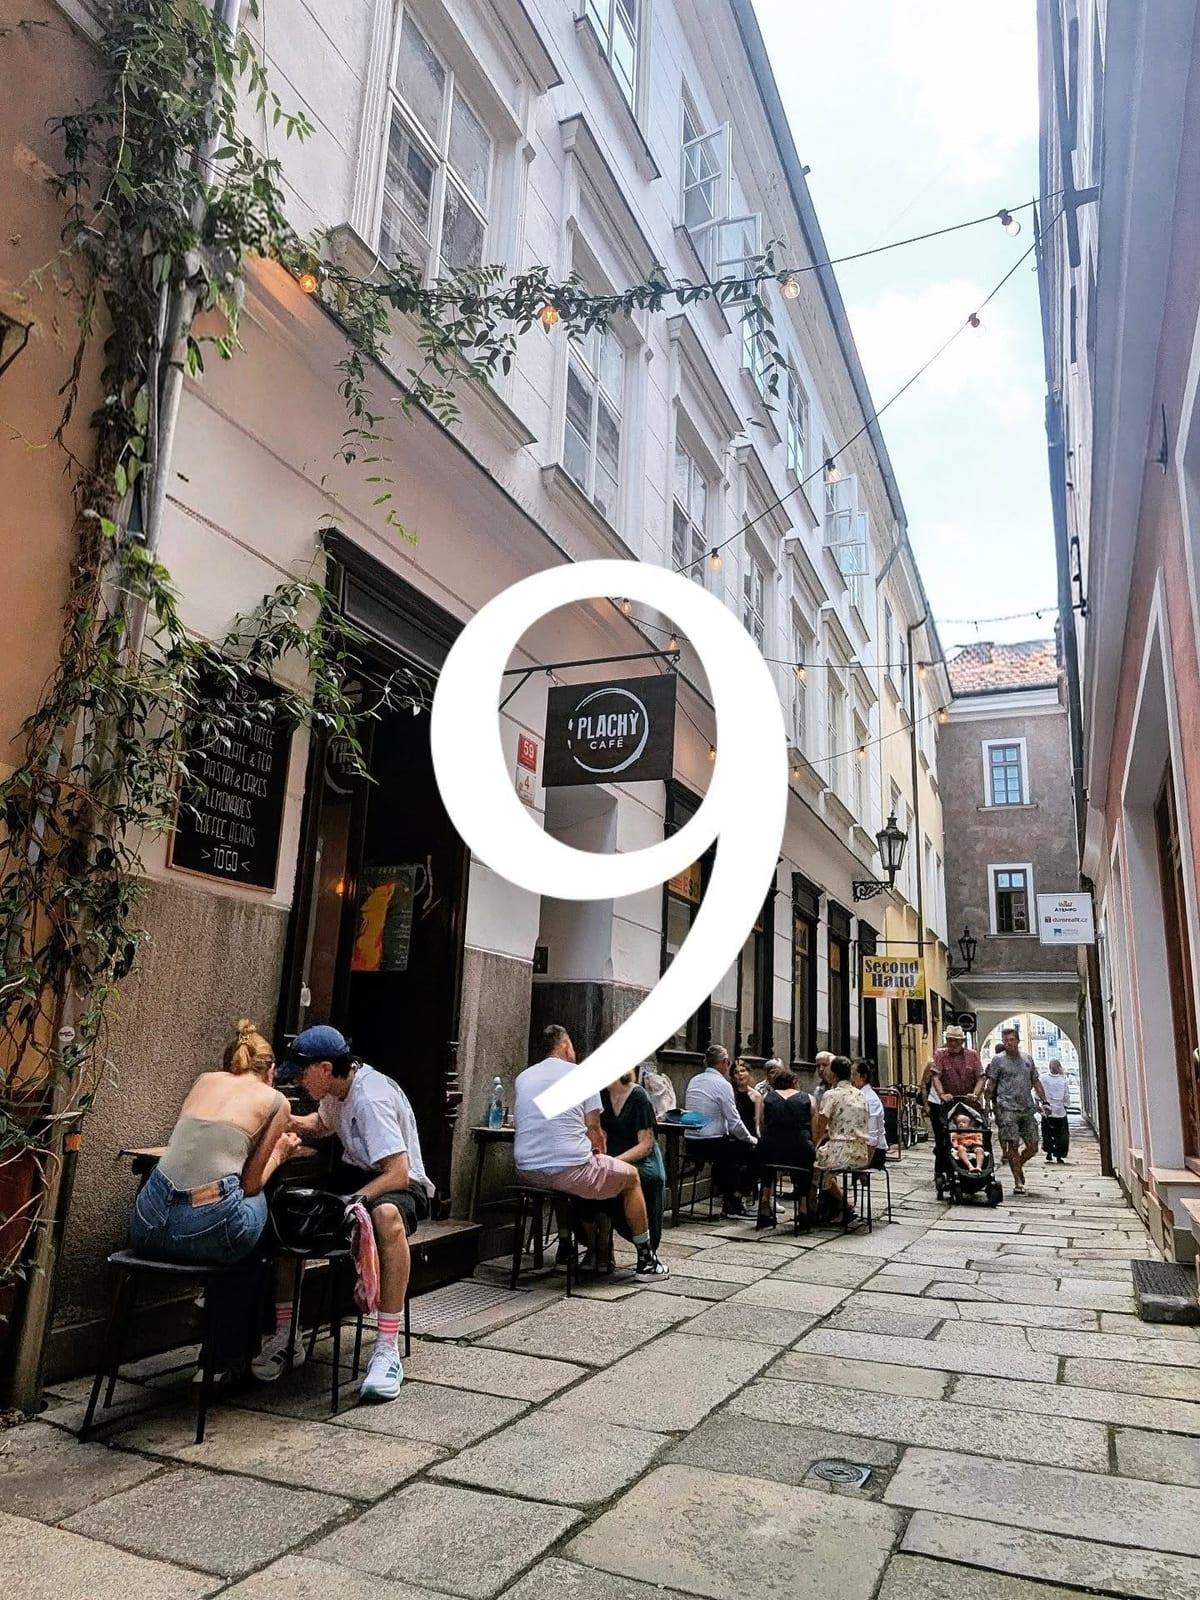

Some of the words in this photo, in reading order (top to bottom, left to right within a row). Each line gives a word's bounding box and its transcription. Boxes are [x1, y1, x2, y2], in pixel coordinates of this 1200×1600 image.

[523, 740, 535, 759] 59
[249, 753, 256, 767] &
[257, 750, 273, 772] TEA
[203, 758, 235, 787] PASTRY
[234, 774, 241, 789] &
[242, 772, 268, 798] CAKES
[205, 788, 252, 819] LEMONADES
[195, 812, 228, 840] COFFEE
[228, 821, 256, 848] BEANS
[865, 959, 919, 974] Second
[872, 973, 915, 988] Hand
